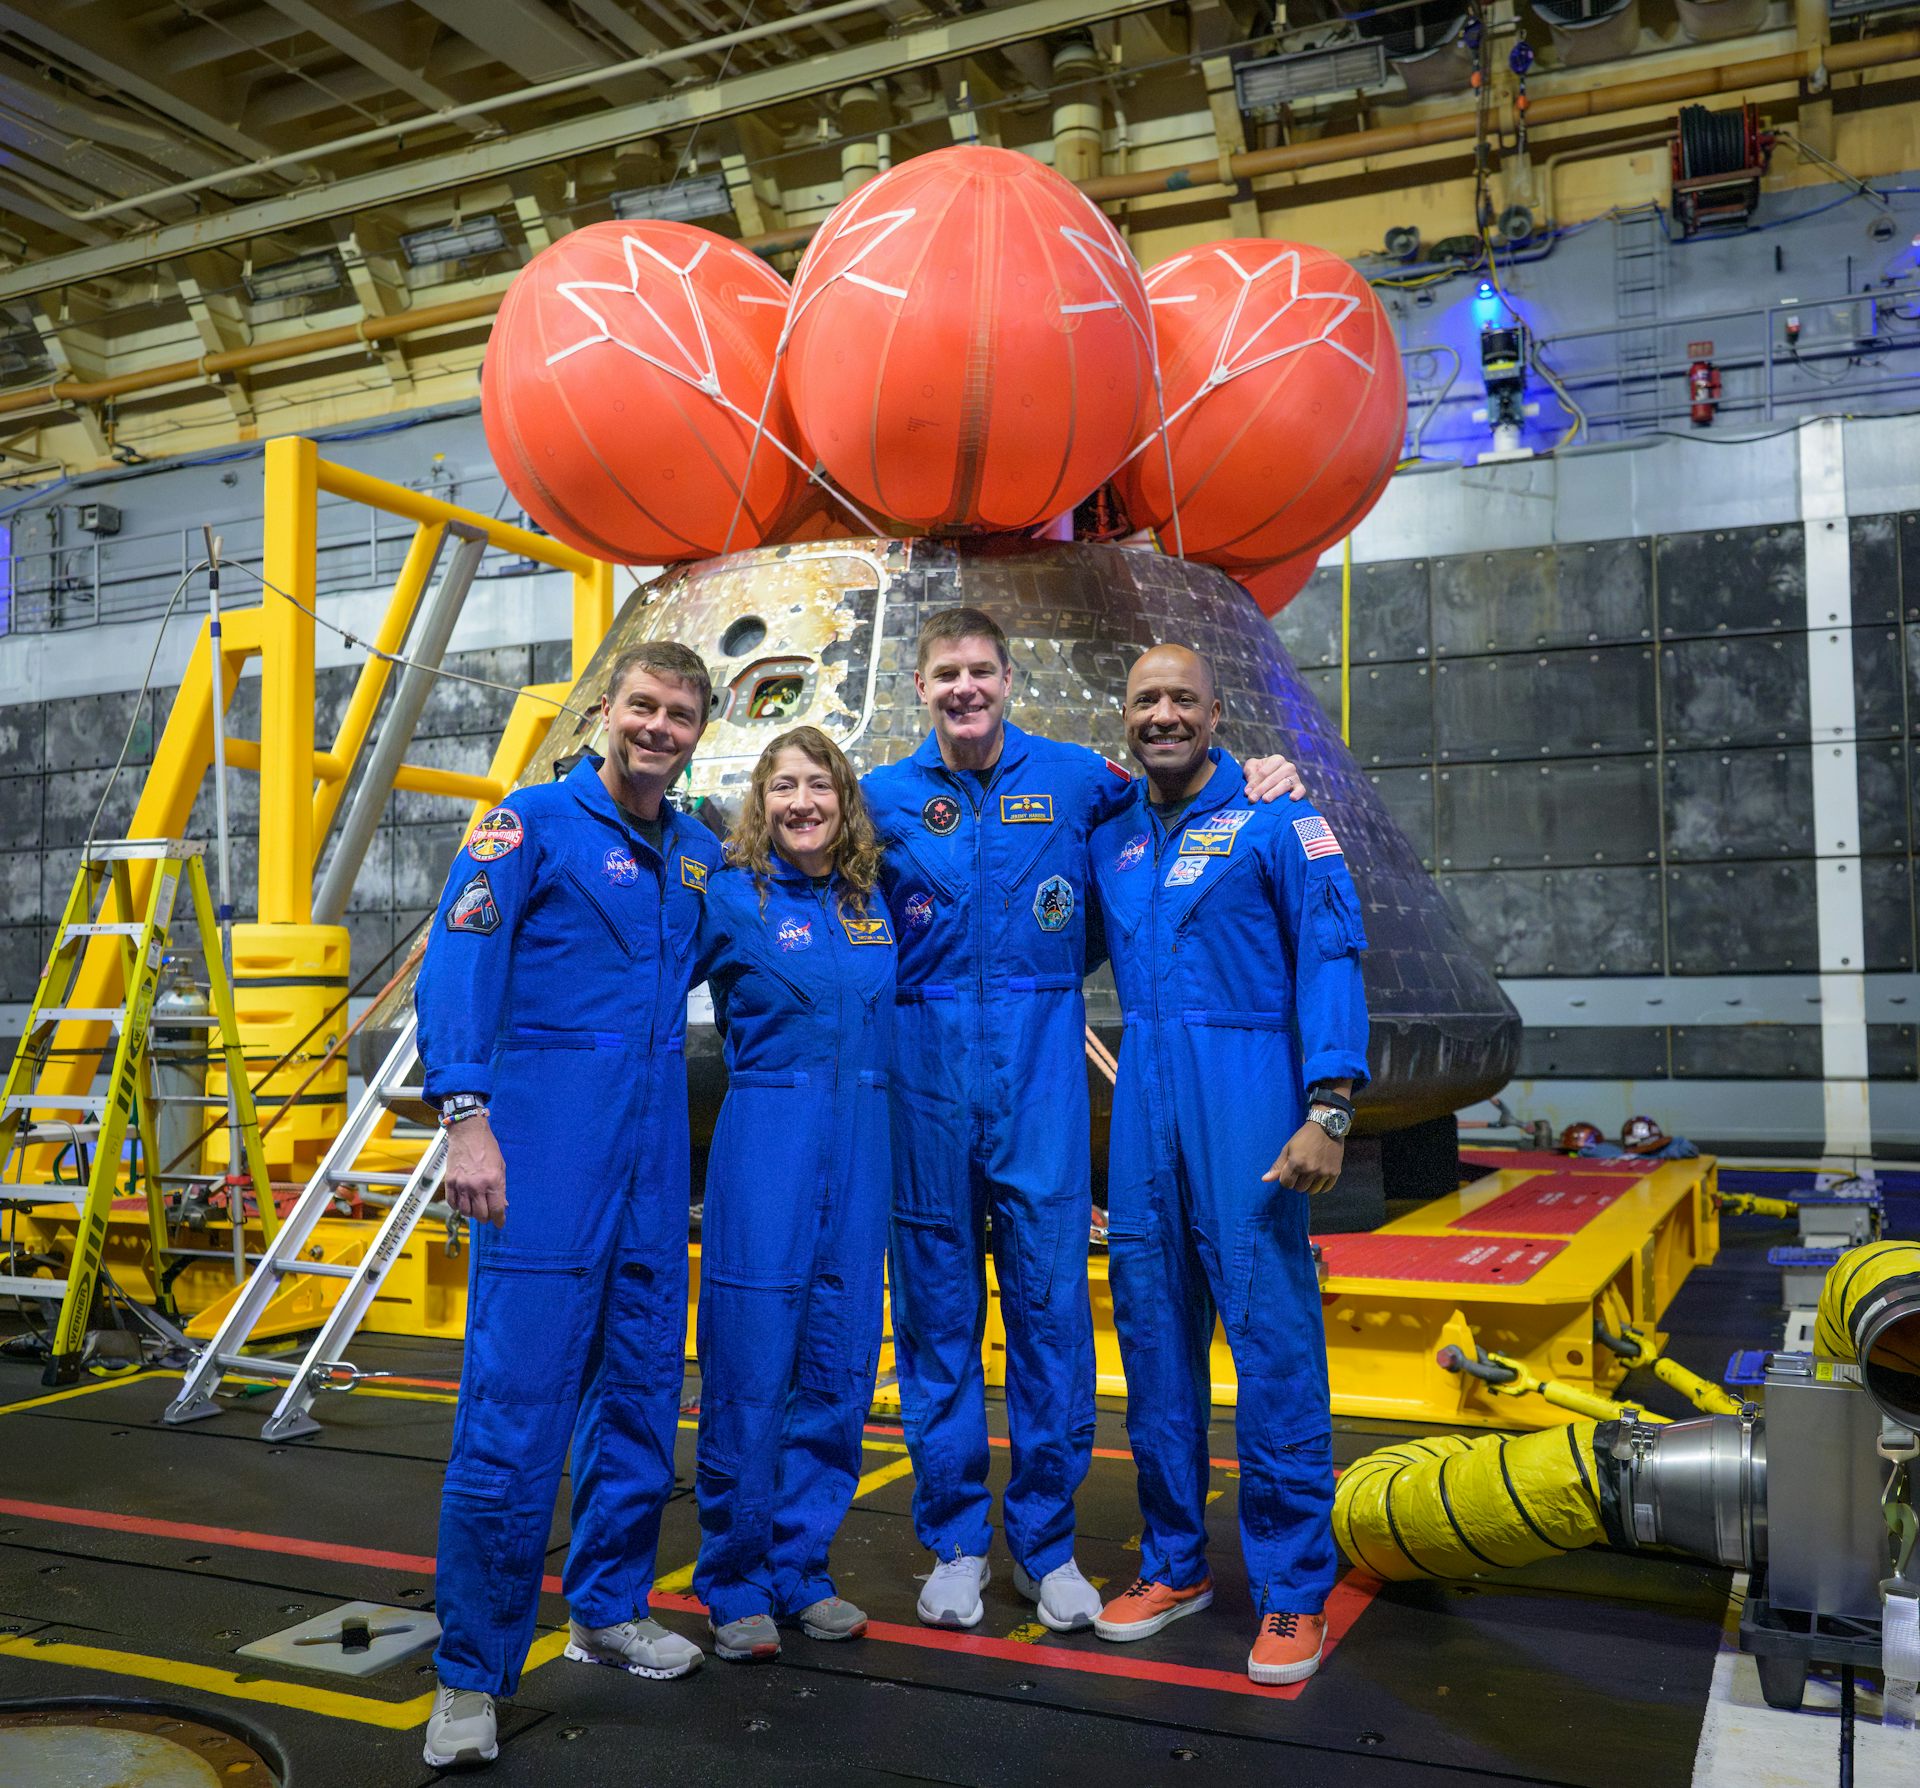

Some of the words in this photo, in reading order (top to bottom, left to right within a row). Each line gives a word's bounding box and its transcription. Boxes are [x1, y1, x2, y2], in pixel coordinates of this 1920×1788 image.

[606, 860, 638, 872] NASA
[778, 927, 811, 941] NASA
[408, 1198, 421, 1215] FOR
[69, 1288, 87, 1345] WERNER
